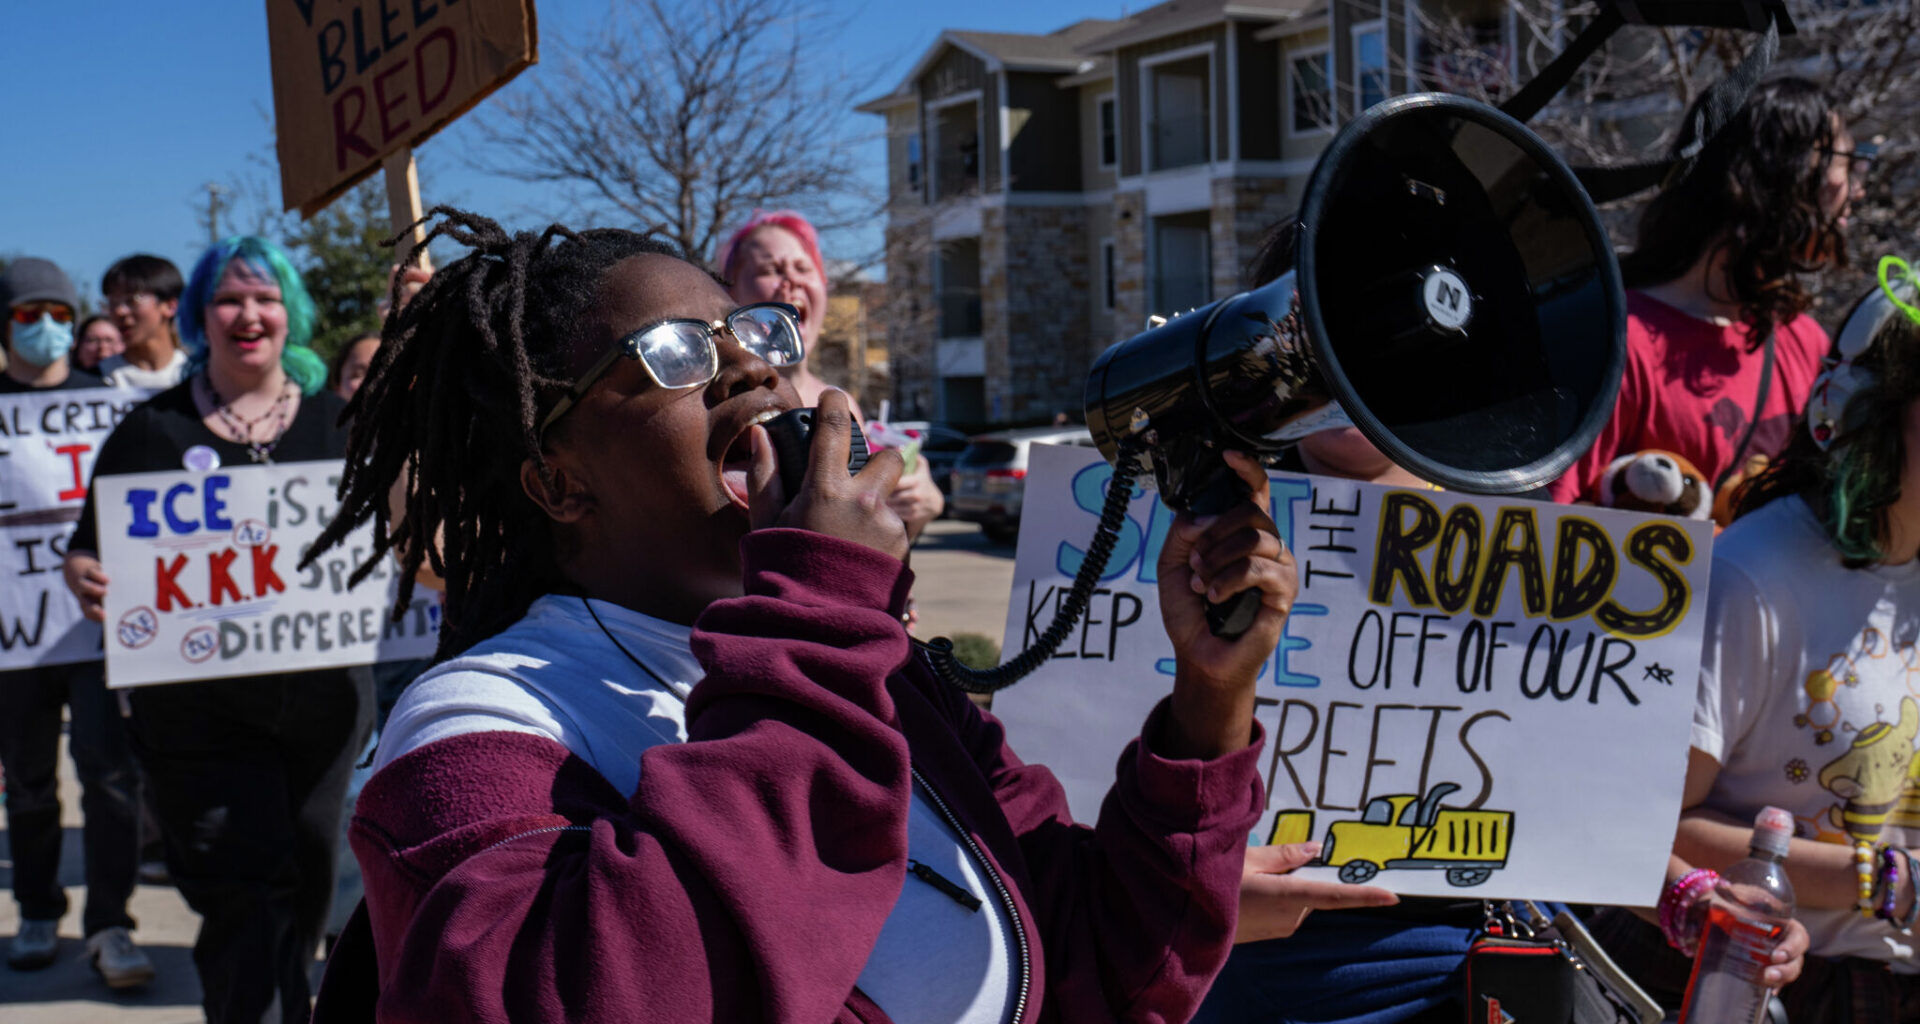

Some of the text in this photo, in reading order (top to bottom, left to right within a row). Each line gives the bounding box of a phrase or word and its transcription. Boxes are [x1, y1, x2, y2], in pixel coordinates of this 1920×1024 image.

[317, 0, 458, 96] BLE
[332, 26, 458, 173] RED
[126, 475, 233, 538] ICE
[1305, 486, 1361, 589] THE
[1368, 489, 1694, 640] ROADS
[1021, 579, 1143, 662] KEEP
[1348, 608, 1452, 690] OFF
[1455, 618, 1516, 693] OF
[1519, 623, 1641, 705] OUR
[1254, 696, 1512, 811] REETS
